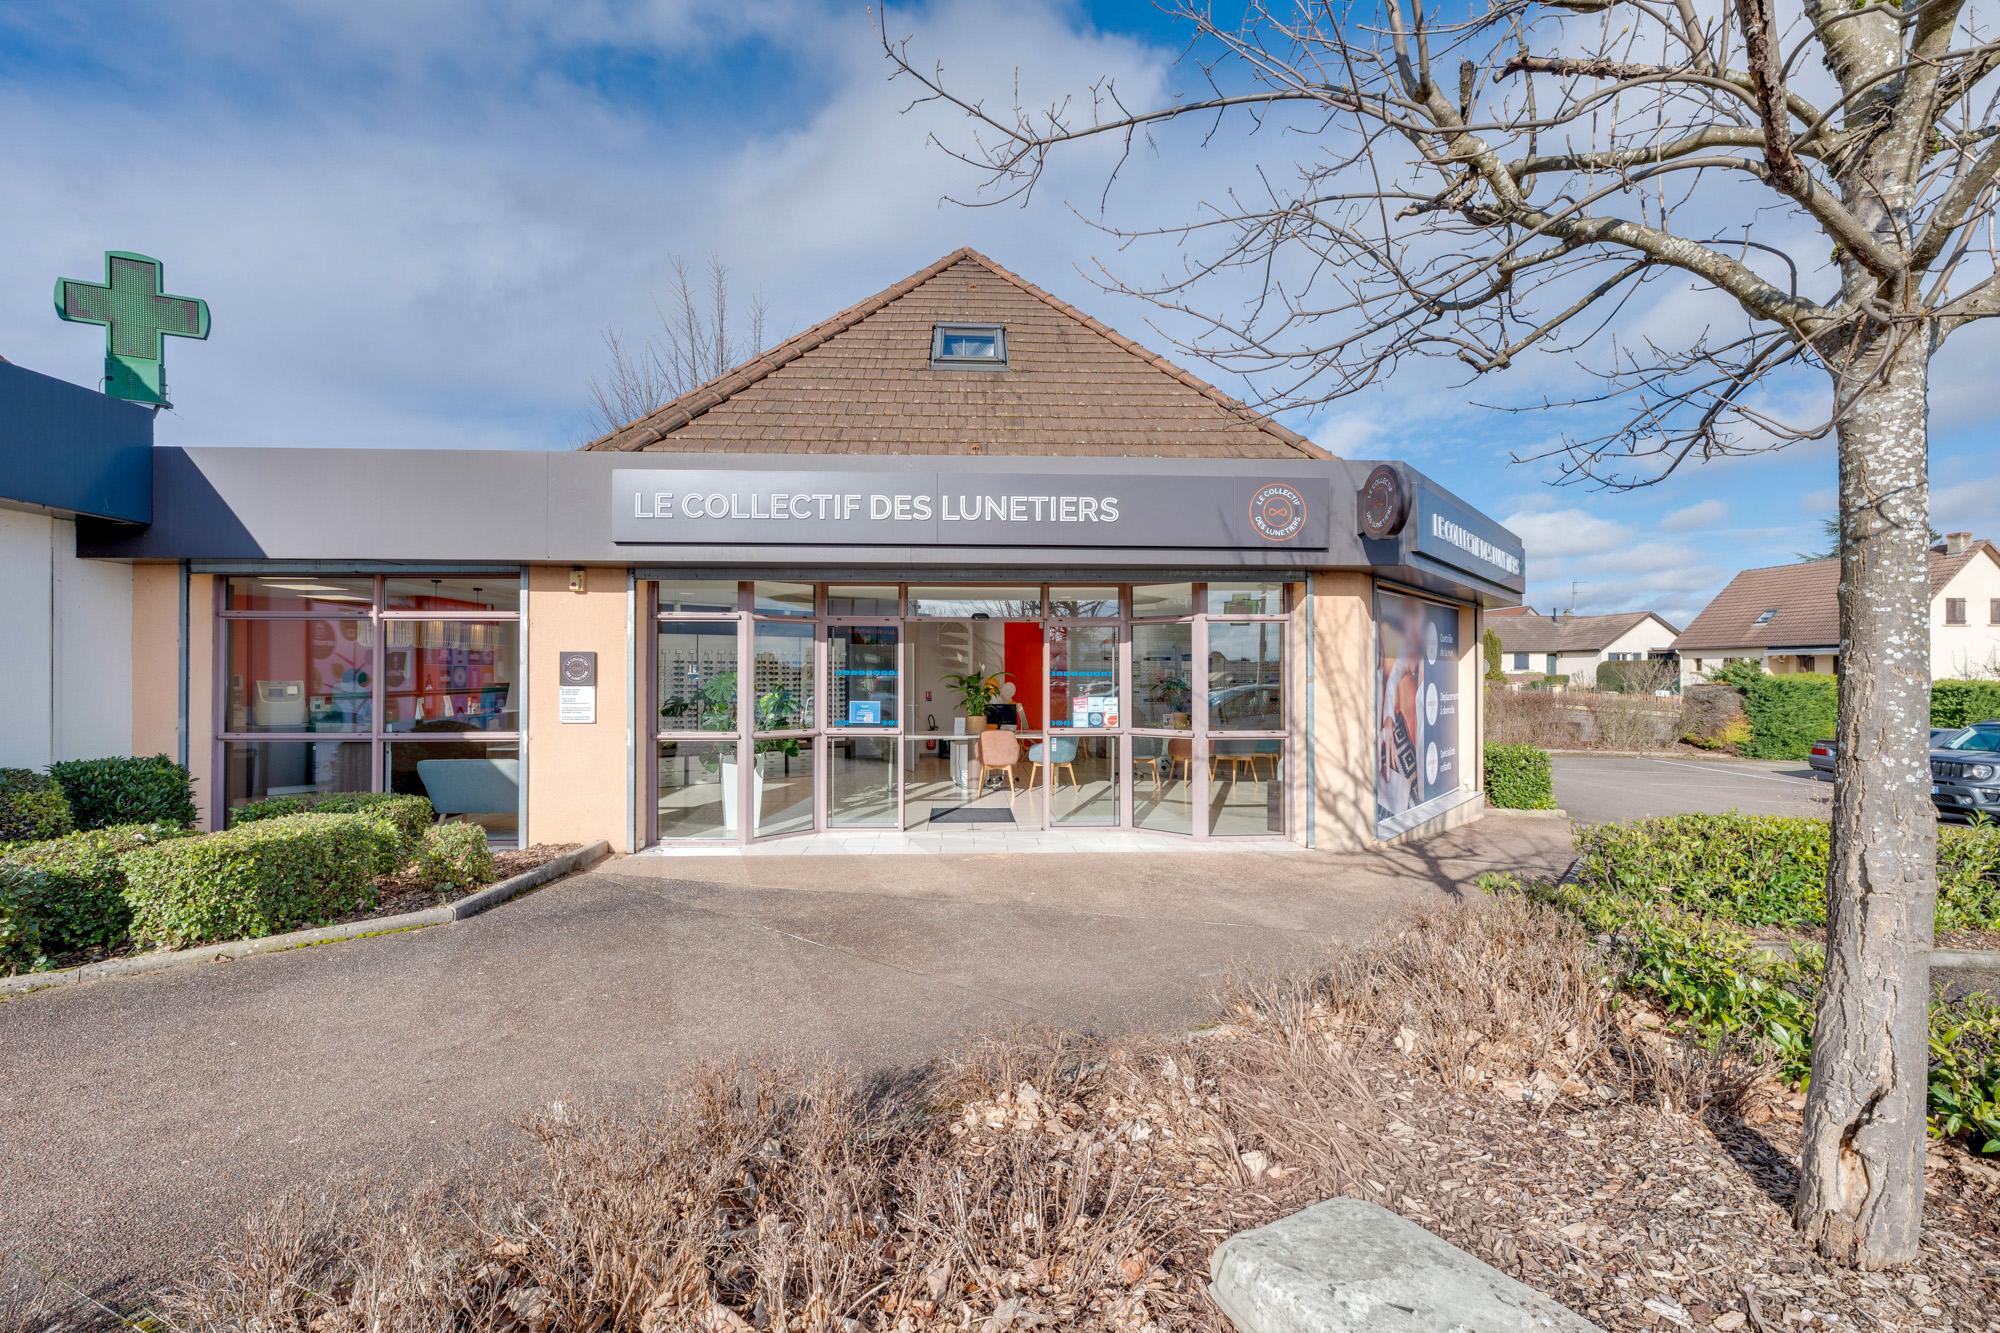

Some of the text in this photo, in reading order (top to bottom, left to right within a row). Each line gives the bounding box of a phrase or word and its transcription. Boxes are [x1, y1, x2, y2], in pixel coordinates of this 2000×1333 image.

[634, 492, 1120, 522] LE COLLECTIF DES LUNETIERS
[1256, 488, 1301, 506] LE COLLECTIF
[1255, 516, 1301, 537] DES LUNETIERS
